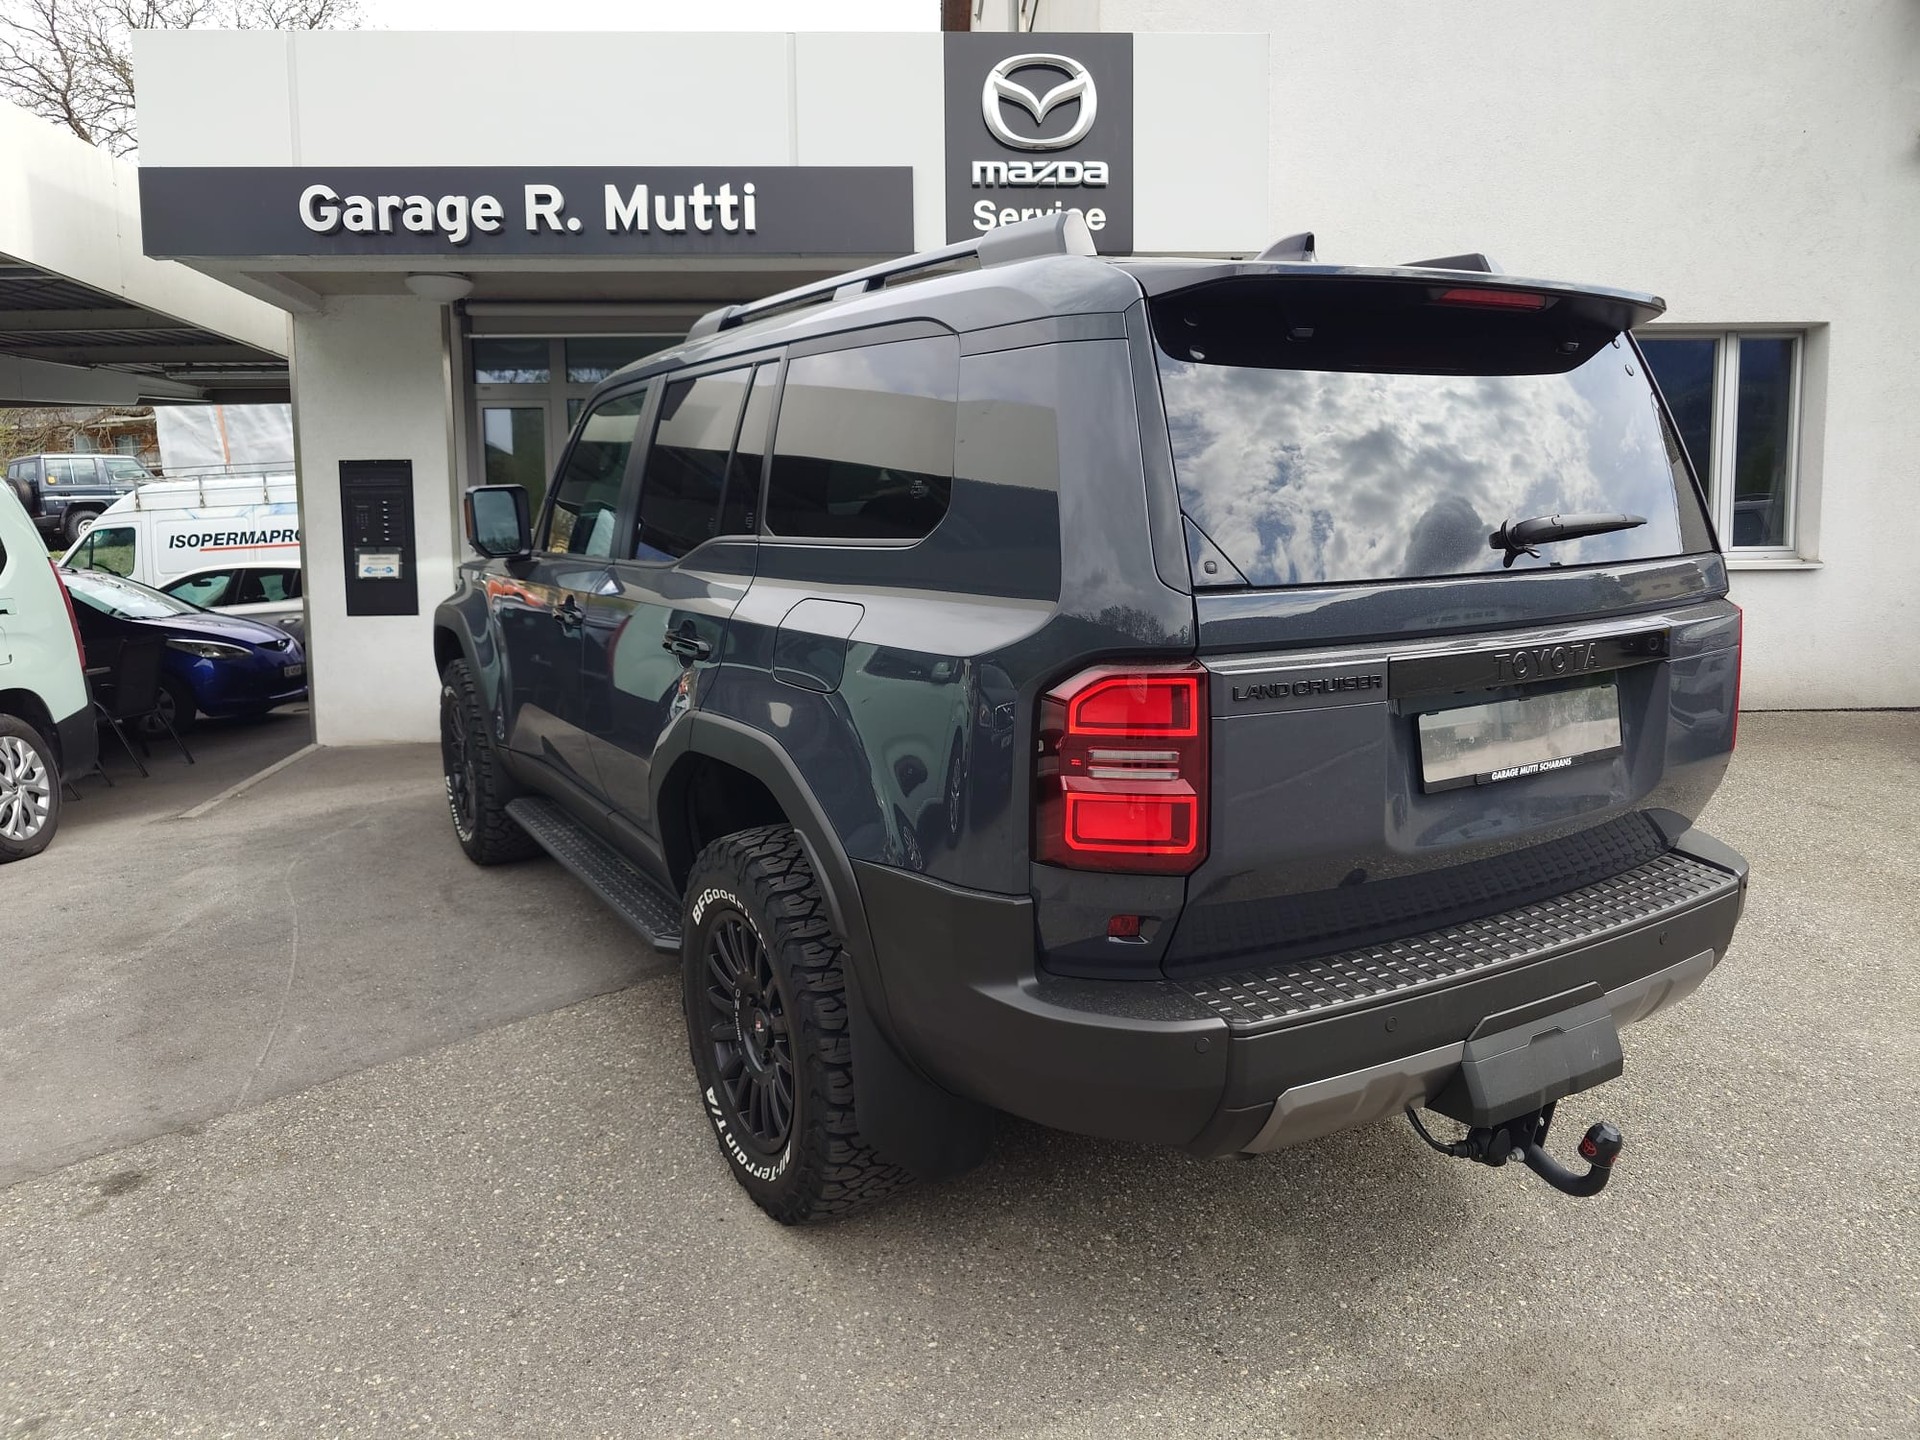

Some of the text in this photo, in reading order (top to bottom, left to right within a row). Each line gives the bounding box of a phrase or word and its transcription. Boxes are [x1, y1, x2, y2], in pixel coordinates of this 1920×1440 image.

[299, 182, 758, 244] Garage R. Mutti
[972, 199, 1107, 231] Sere
[168, 529, 300, 549] ISOPERMAPR
[1494, 642, 1601, 682] TOYOTA
[1232, 674, 1383, 701] LAND CRUISER
[1491, 757, 1573, 781] GARAGE MUTTI SCHARANS
[706, 1086, 727, 1134] T/A
